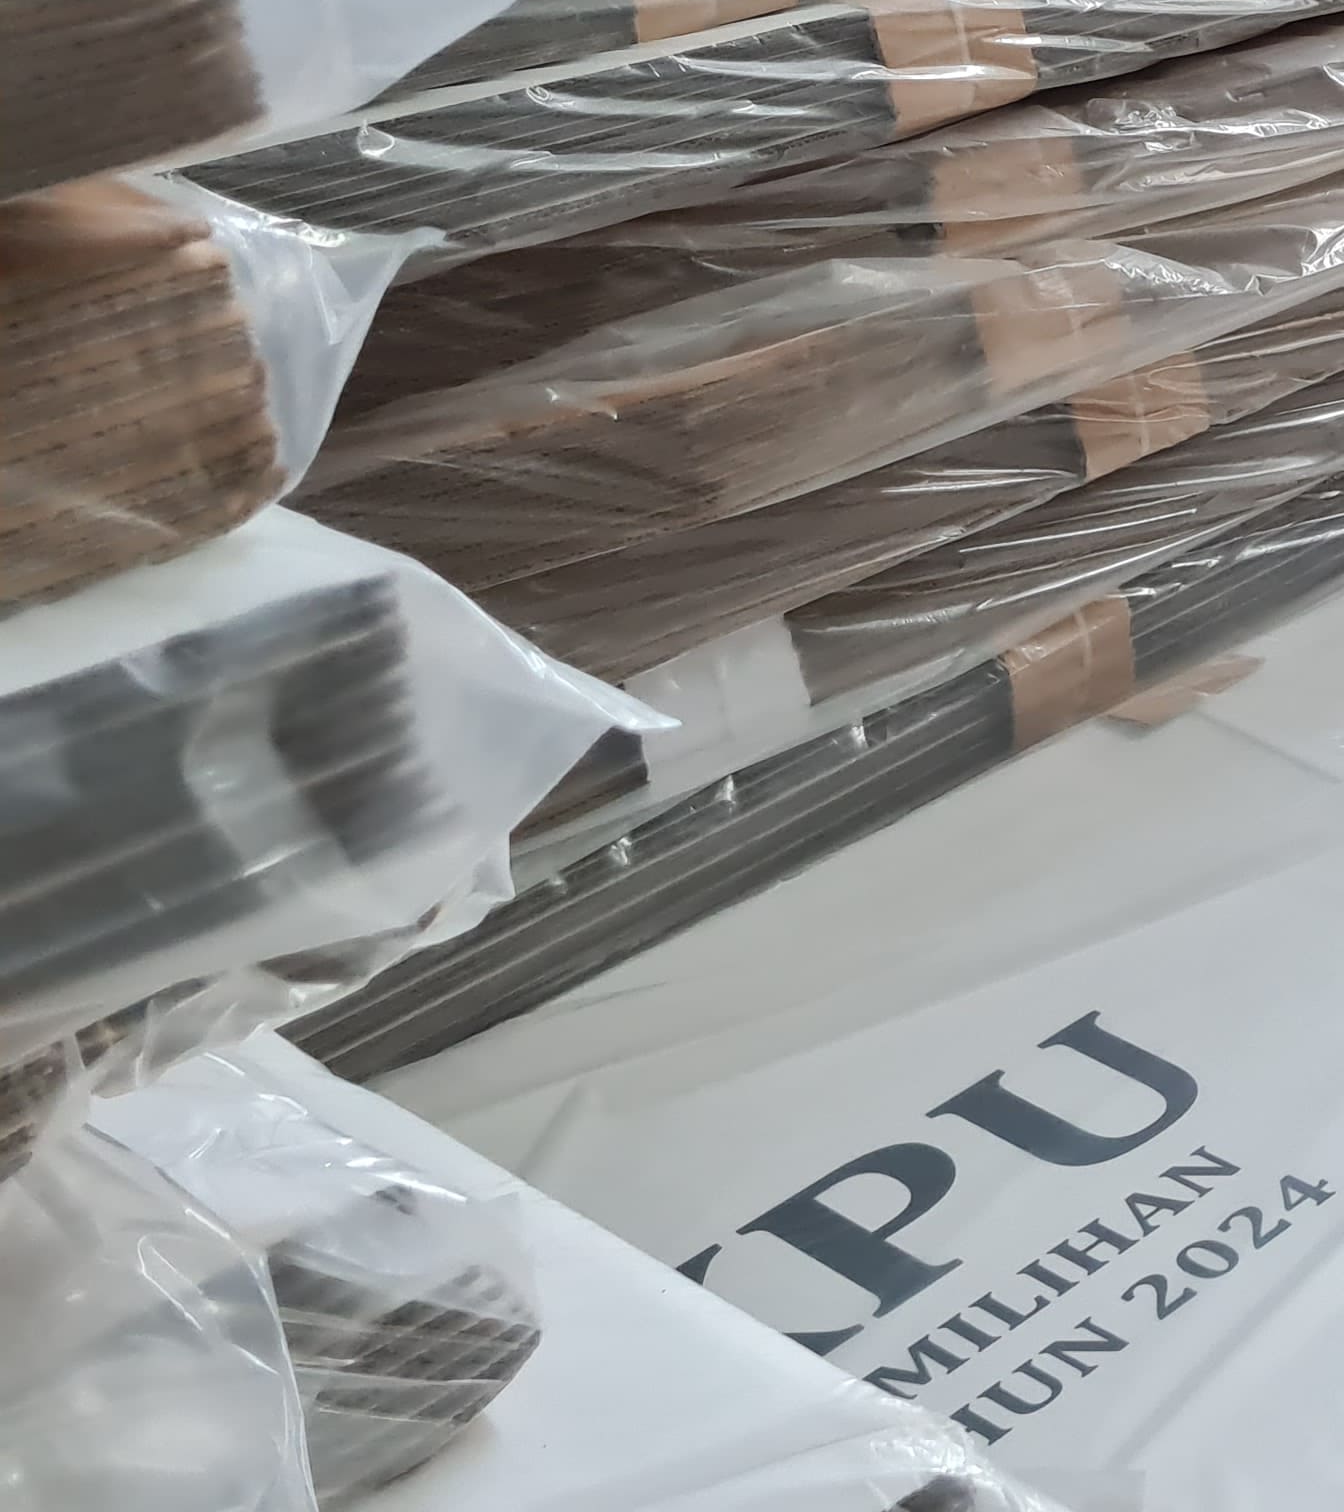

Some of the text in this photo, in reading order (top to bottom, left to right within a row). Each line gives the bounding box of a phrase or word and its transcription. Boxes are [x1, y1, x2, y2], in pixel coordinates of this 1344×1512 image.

[862, 1144, 1241, 1400] MILIHAN
[949, 1173, 1337, 1446] HUN 2024
